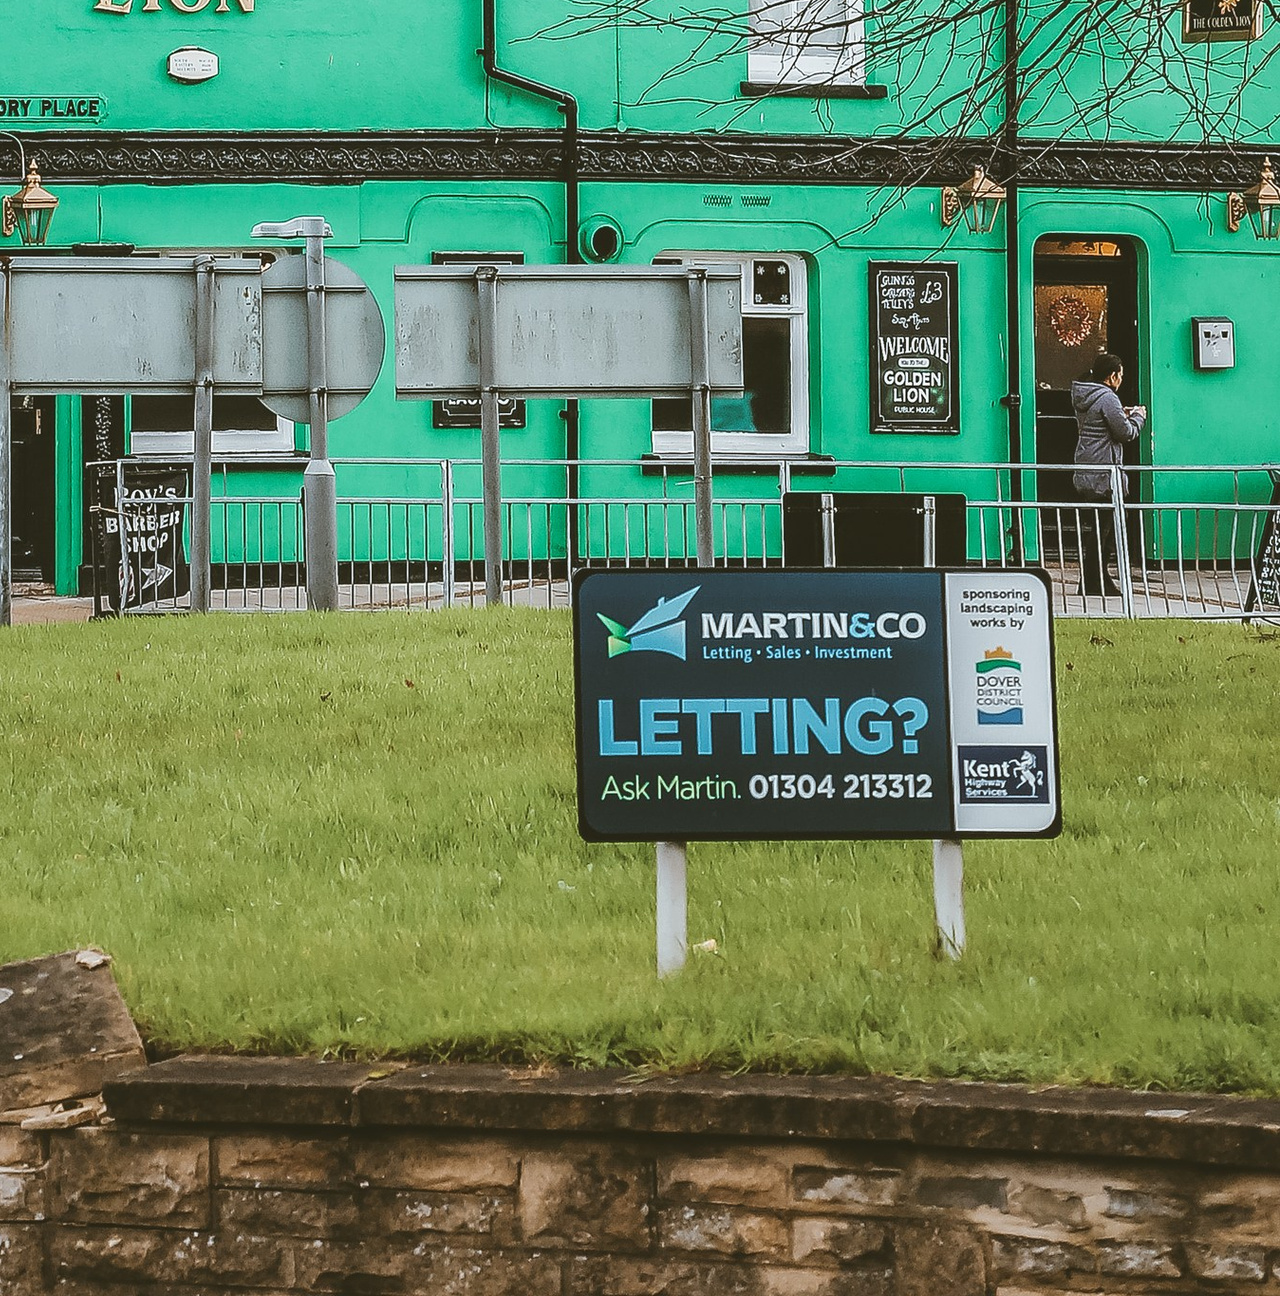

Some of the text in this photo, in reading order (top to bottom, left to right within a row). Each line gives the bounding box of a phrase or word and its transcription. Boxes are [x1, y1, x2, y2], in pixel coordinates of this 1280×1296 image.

[1193, 18, 1206, 29] THE
[1207, 17, 1233, 28] GOLDEN
[41, 99, 100, 117] PLACE
[919, 280, 943, 304] £3
[878, 336, 949, 364] WELCOME
[883, 370, 942, 387] GOLDEN
[893, 388, 930, 403] LION
[894, 406, 935, 415] PUBLIC HOUSE
[105, 510, 180, 534] BARBER
[962, 588, 1031, 602] sponsoring
[960, 603, 1033, 616] landscaping
[701, 612, 927, 640] MARTIN&CO
[970, 617, 1025, 630] works by
[703, 645, 893, 663] Letting Sales Investment
[976, 676, 1022, 687] DOVER
[977, 688, 1022, 697] DISTRICT
[976, 697, 1024, 706] COUNCIL
[598, 696, 929, 756] LETTING?
[963, 759, 1011, 778] Kent
[601, 772, 933, 800] Ask Martin. 01304 213312
[965, 778, 1007, 788] Highway
[965, 787, 1008, 796] Services
